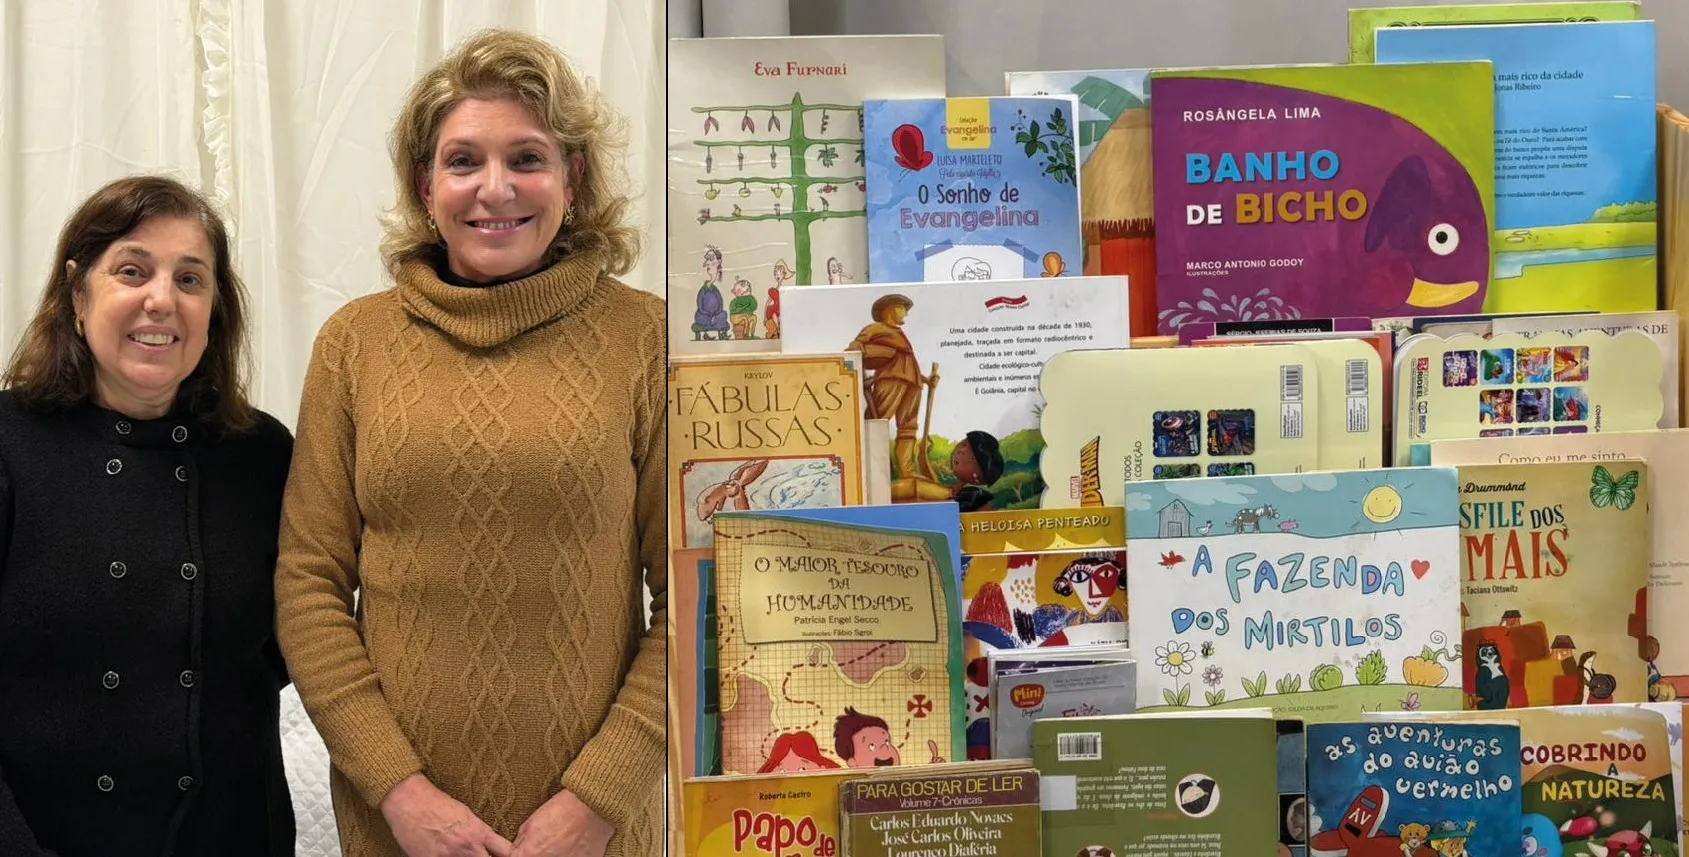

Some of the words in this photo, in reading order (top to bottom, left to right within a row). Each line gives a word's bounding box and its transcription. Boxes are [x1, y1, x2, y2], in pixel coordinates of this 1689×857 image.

[754, 61, 781, 76] Eva
[786, 61, 847, 76] Furnari
[1498, 72, 1520, 81] mais
[1520, 72, 1539, 81] rico
[1540, 70, 1552, 80] da
[1553, 69, 1585, 80] cidade
[1514, 82, 1542, 91] Ribeiro
[1183, 107, 1277, 122] ROSÂNGELA
[1284, 106, 1321, 119] LIMA
[940, 125, 997, 137] Evangelina
[937, 154, 957, 167] LUÍSA
[960, 153, 1003, 166] MARTELETO
[1186, 149, 1340, 184] BANHO
[918, 184, 929, 205] O
[936, 181, 991, 205] Sonho
[1000, 181, 1020, 203] de
[1186, 203, 1223, 225] DE
[1235, 188, 1368, 224] BICHO
[900, 205, 1040, 232] Evangelina
[1186, 260, 1222, 271] MARCO
[1224, 259, 1266, 270] ANTONIO
[1269, 257, 1304, 268] GODOY
[949, 327, 966, 335] Uma
[967, 325, 989, 334] cidade
[991, 324, 1025, 333] construída
[1038, 322, 1062, 331] década
[1063, 321, 1072, 330] de
[1074, 321, 1093, 330] 1930,
[1652, 323, 1669, 335] DE
[940, 339, 974, 348] planejada,
[976, 338, 1001, 348] traçada
[1016, 336, 1042, 345] formato
[1044, 333, 1087, 343] radiocêntrico
[964, 350, 996, 359] destinada
[1003, 350, 1013, 358] ser
[1014, 348, 1038, 358] capital.
[979, 362, 1001, 370] Cidade
[964, 375, 997, 384] ambientais
[1004, 374, 1032, 383] inúmeros
[676, 381, 843, 416] FÁBULAS
[975, 387, 980, 395] É
[981, 386, 1006, 396] Goiânia,
[1007, 386, 1027, 395] capital
[691, 415, 832, 450] RUSSAS
[1133, 440, 1143, 478] COLEÇÃO
[971, 518, 1033, 532] HELOISA
[1038, 515, 1111, 529] PENTEADO
[1529, 504, 1565, 529] DOS
[1191, 544, 1213, 578] A
[1464, 527, 1570, 582] MAIS
[754, 557, 771, 573] O
[775, 555, 841, 575] MAIOR
[841, 557, 919, 579] TESOURO
[827, 577, 851, 590] DA
[1225, 551, 1405, 604] FAZENDA
[766, 593, 914, 615] HUMANIDADE
[794, 615, 827, 625] Patrícia
[828, 615, 852, 626] Engel
[854, 615, 880, 625] Secco
[1170, 606, 1230, 636] DOS
[1244, 609, 1403, 651] MIRTILOS
[833, 629, 853, 637] Fábio
[1013, 686, 1042, 702] Mini
[1324, 735, 1357, 761] as
[1366, 723, 1503, 758] aventuras
[1363, 752, 1393, 774] do
[1403, 751, 1480, 776] avião
[1520, 742, 1647, 766] COBRINDO
[1607, 762, 1619, 776] A
[759, 791, 787, 801] Roberta
[787, 790, 812, 800] Castro
[857, 783, 899, 800] PARA
[900, 779, 962, 797] GOSTAR
[966, 777, 988, 794] DE
[992, 775, 1024, 791] LER
[1395, 774, 1513, 800] vermelho
[1541, 778, 1666, 802] NATUREZA
[899, 797, 933, 809] Volume
[870, 814, 911, 831] Carlos
[912, 810, 967, 828] Eduardo
[970, 809, 1014, 825] Novaes
[732, 807, 817, 857] Papo
[881, 830, 910, 846] José
[911, 829, 952, 844] Carlos
[954, 826, 1002, 841] Oliveira
[813, 832, 836, 857] de
[949, 842, 997, 857] Diaféria
